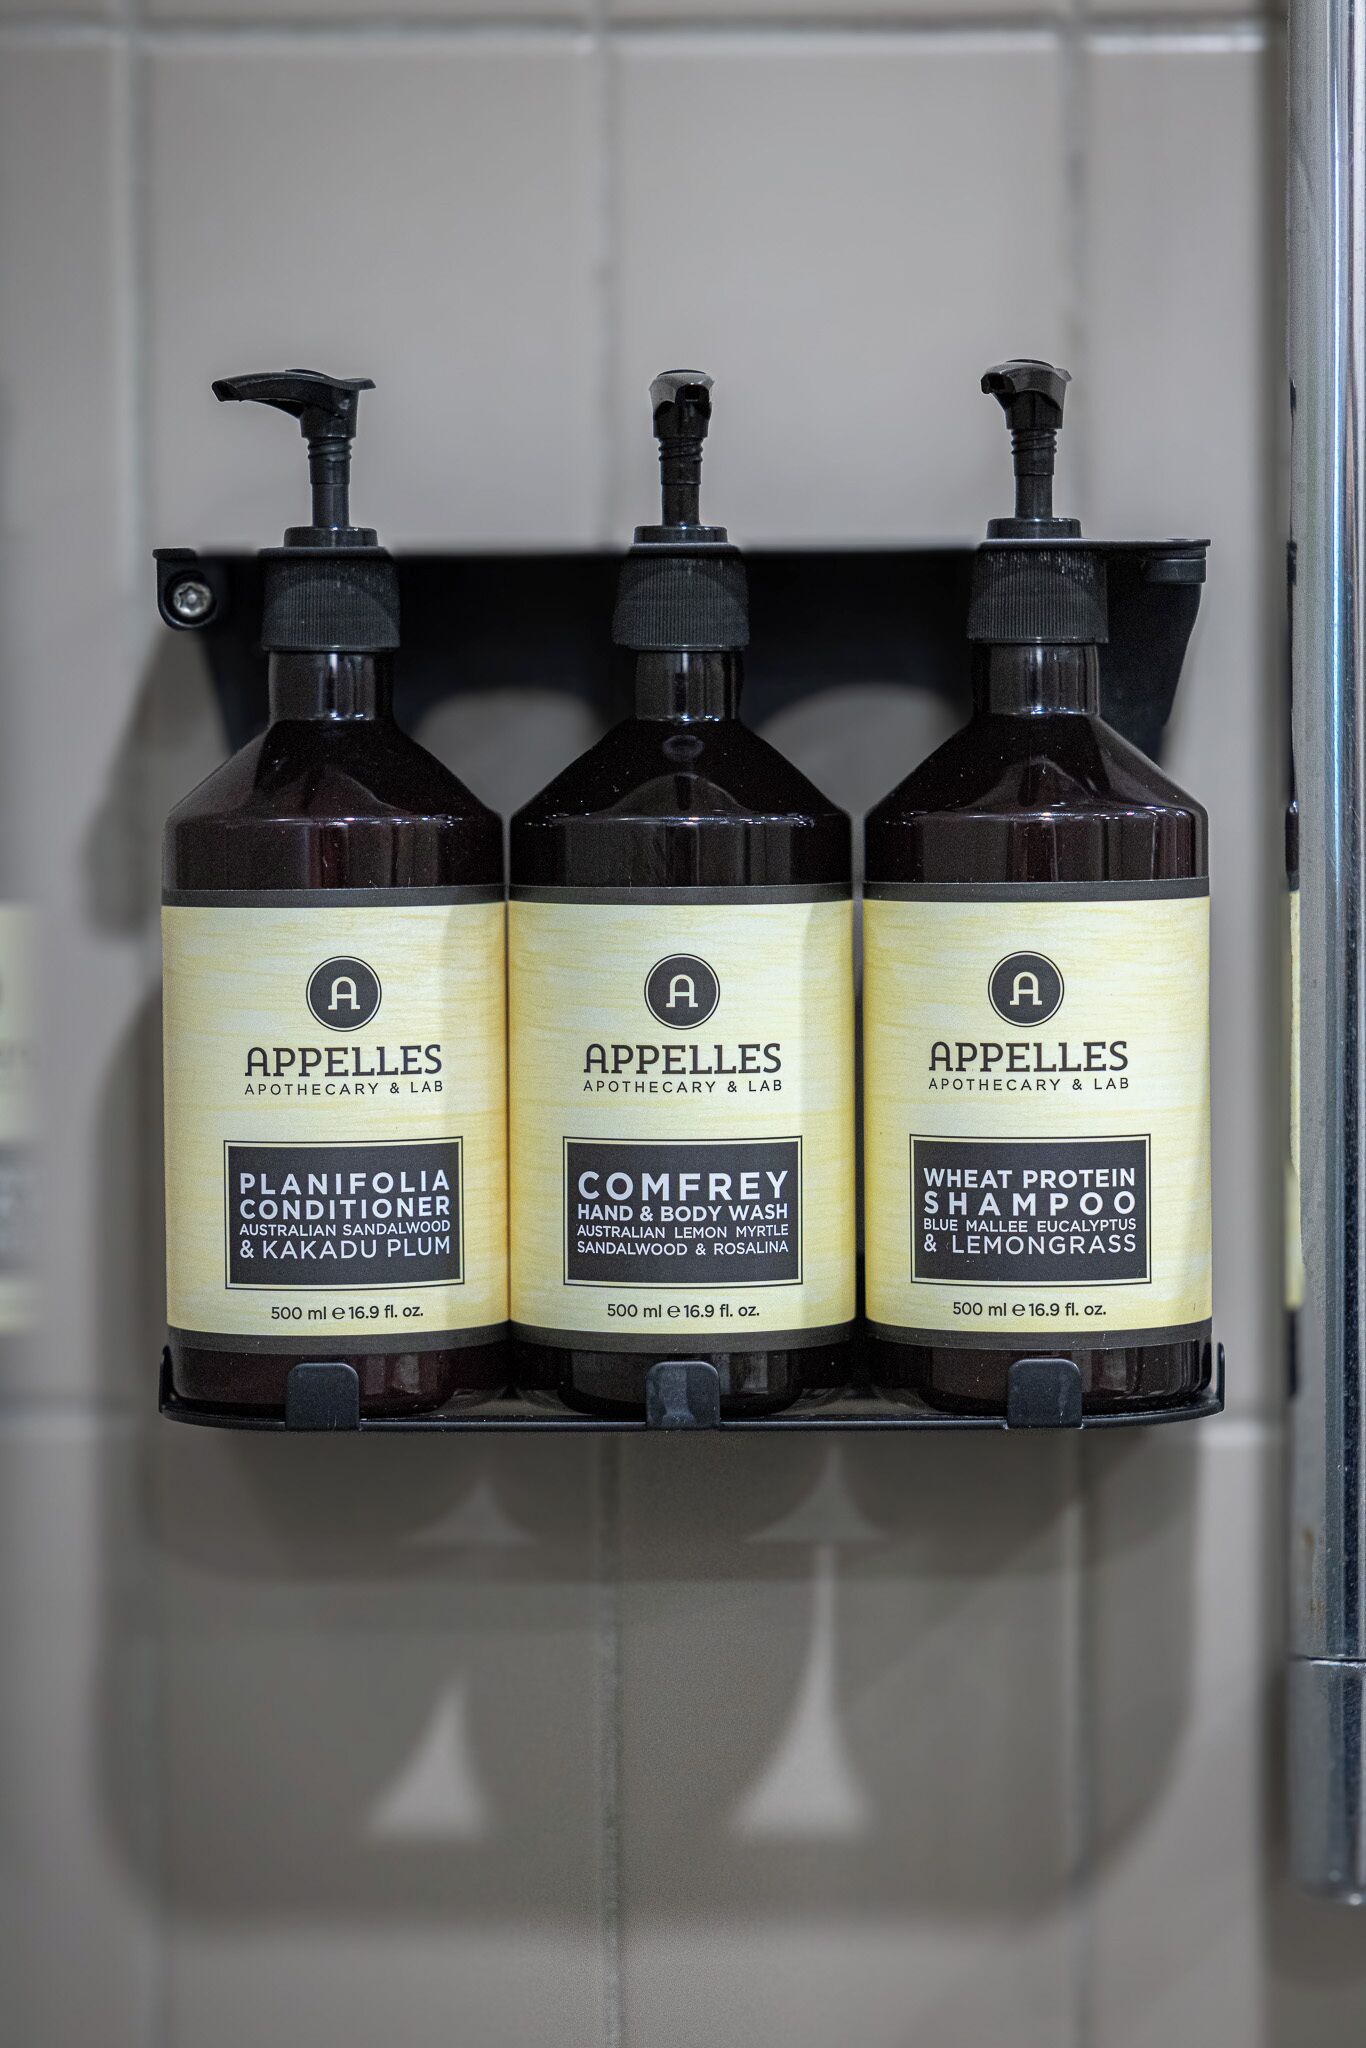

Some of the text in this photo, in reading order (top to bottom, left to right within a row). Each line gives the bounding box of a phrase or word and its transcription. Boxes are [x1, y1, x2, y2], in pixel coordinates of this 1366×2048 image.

[328, 976, 360, 1010] A
[666, 974, 698, 1008] A
[1009, 971, 1042, 1006] A
[245, 1044, 442, 1077] APPELLES
[584, 1043, 781, 1074] APPELLES
[929, 1040, 1129, 1072] APPELLES
[245, 1081, 442, 1095] APOTHECARY & LAB
[583, 1080, 782, 1093] APOTHECARY & LAB
[929, 1077, 1129, 1091] APOTHECARY & LAB
[240, 1169, 449, 1194] PLANIFOLIA
[578, 1170, 788, 1201] COMFREY
[924, 1168, 1135, 1189] WHEAT PROTEIN
[240, 1196, 450, 1220] CONDITIONER
[578, 1204, 788, 1222] HAND & BODY WASH
[924, 1190, 1136, 1216] SHAMPOO
[239, 1220, 450, 1236] AUSTRALIAN SANDALWOOD
[577, 1224, 789, 1239] AUSTRALIAN LEMON MYRTLE
[924, 1218, 1136, 1233] BLUE MALLEE EUCALYPTUS
[240, 1236, 450, 1259] & KAKADU PLUM
[577, 1241, 788, 1256] SANDALWOOD & ROSALINA
[924, 1233, 1136, 1255] & LEMONGRASS
[271, 1306, 302, 1320] 500
[308, 1306, 327, 1320] ml
[348, 1305, 379, 1319] 16.9
[383, 1304, 398, 1318] fl.
[403, 1306, 423, 1317] oz.
[607, 1304, 637, 1318] 500
[643, 1304, 662, 1318] ml
[684, 1304, 714, 1318] 16.9
[719, 1304, 734, 1318] fl.
[738, 1306, 759, 1317] oz.
[952, 1302, 983, 1316] 500
[988, 1302, 1007, 1316] ml
[1029, 1303, 1060, 1316] 16.9
[1064, 1301, 1079, 1316] fl.
[1084, 1304, 1106, 1316] oz.
